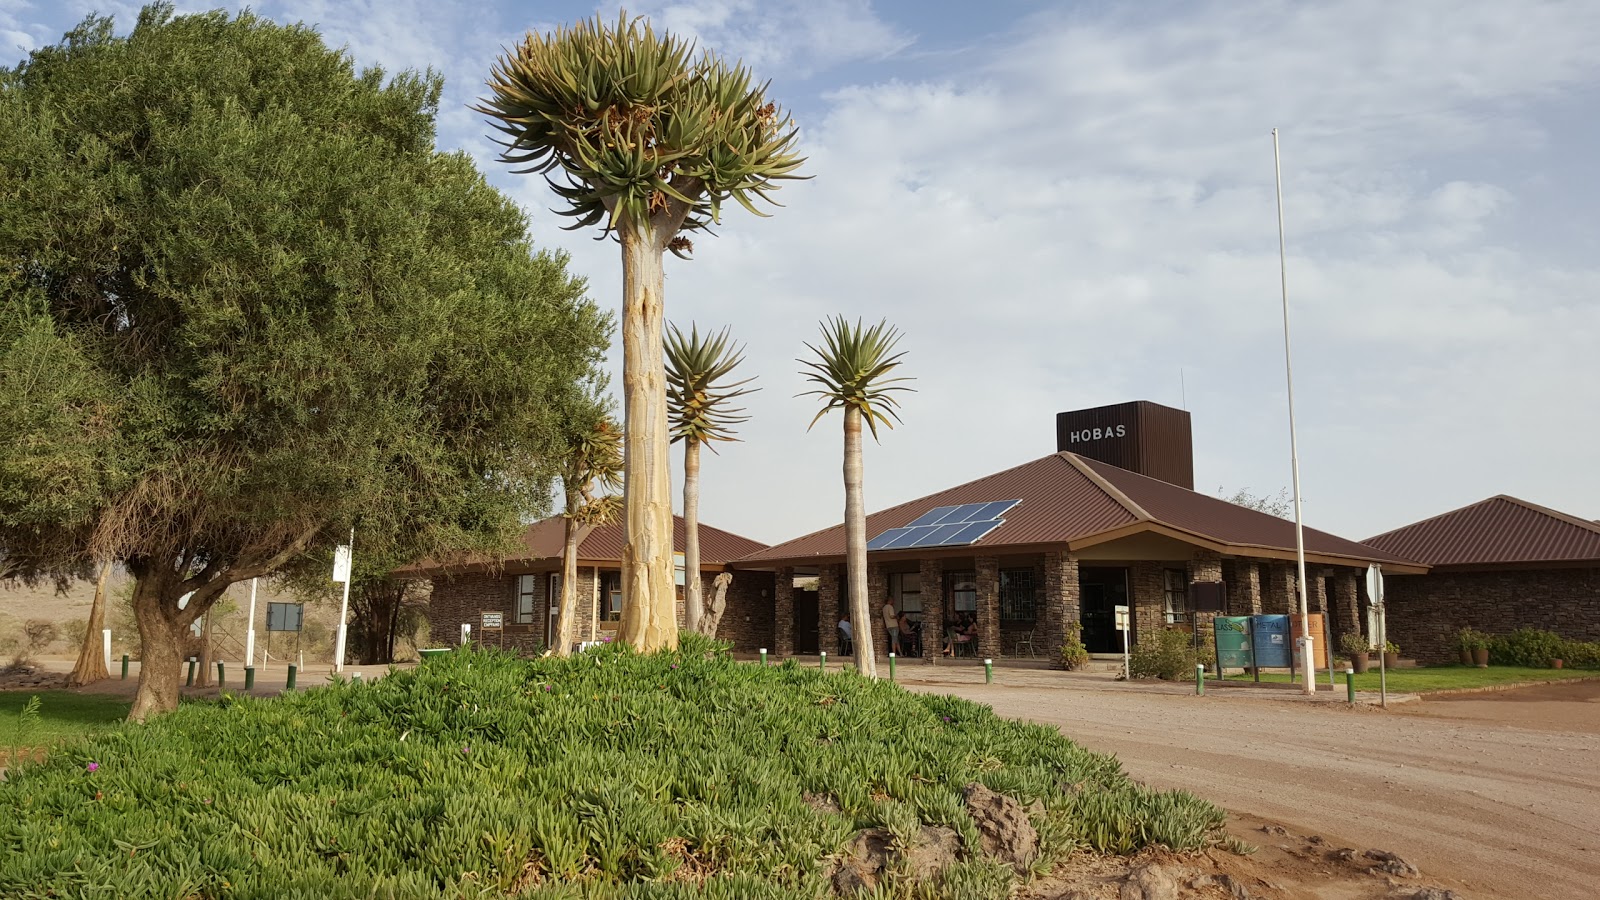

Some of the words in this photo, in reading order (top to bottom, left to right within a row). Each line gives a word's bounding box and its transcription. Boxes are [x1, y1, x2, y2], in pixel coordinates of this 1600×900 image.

[1070, 424, 1126, 443] HOBAS
[1256, 621, 1281, 629] METAL
[1294, 620, 1318, 628] OTER
